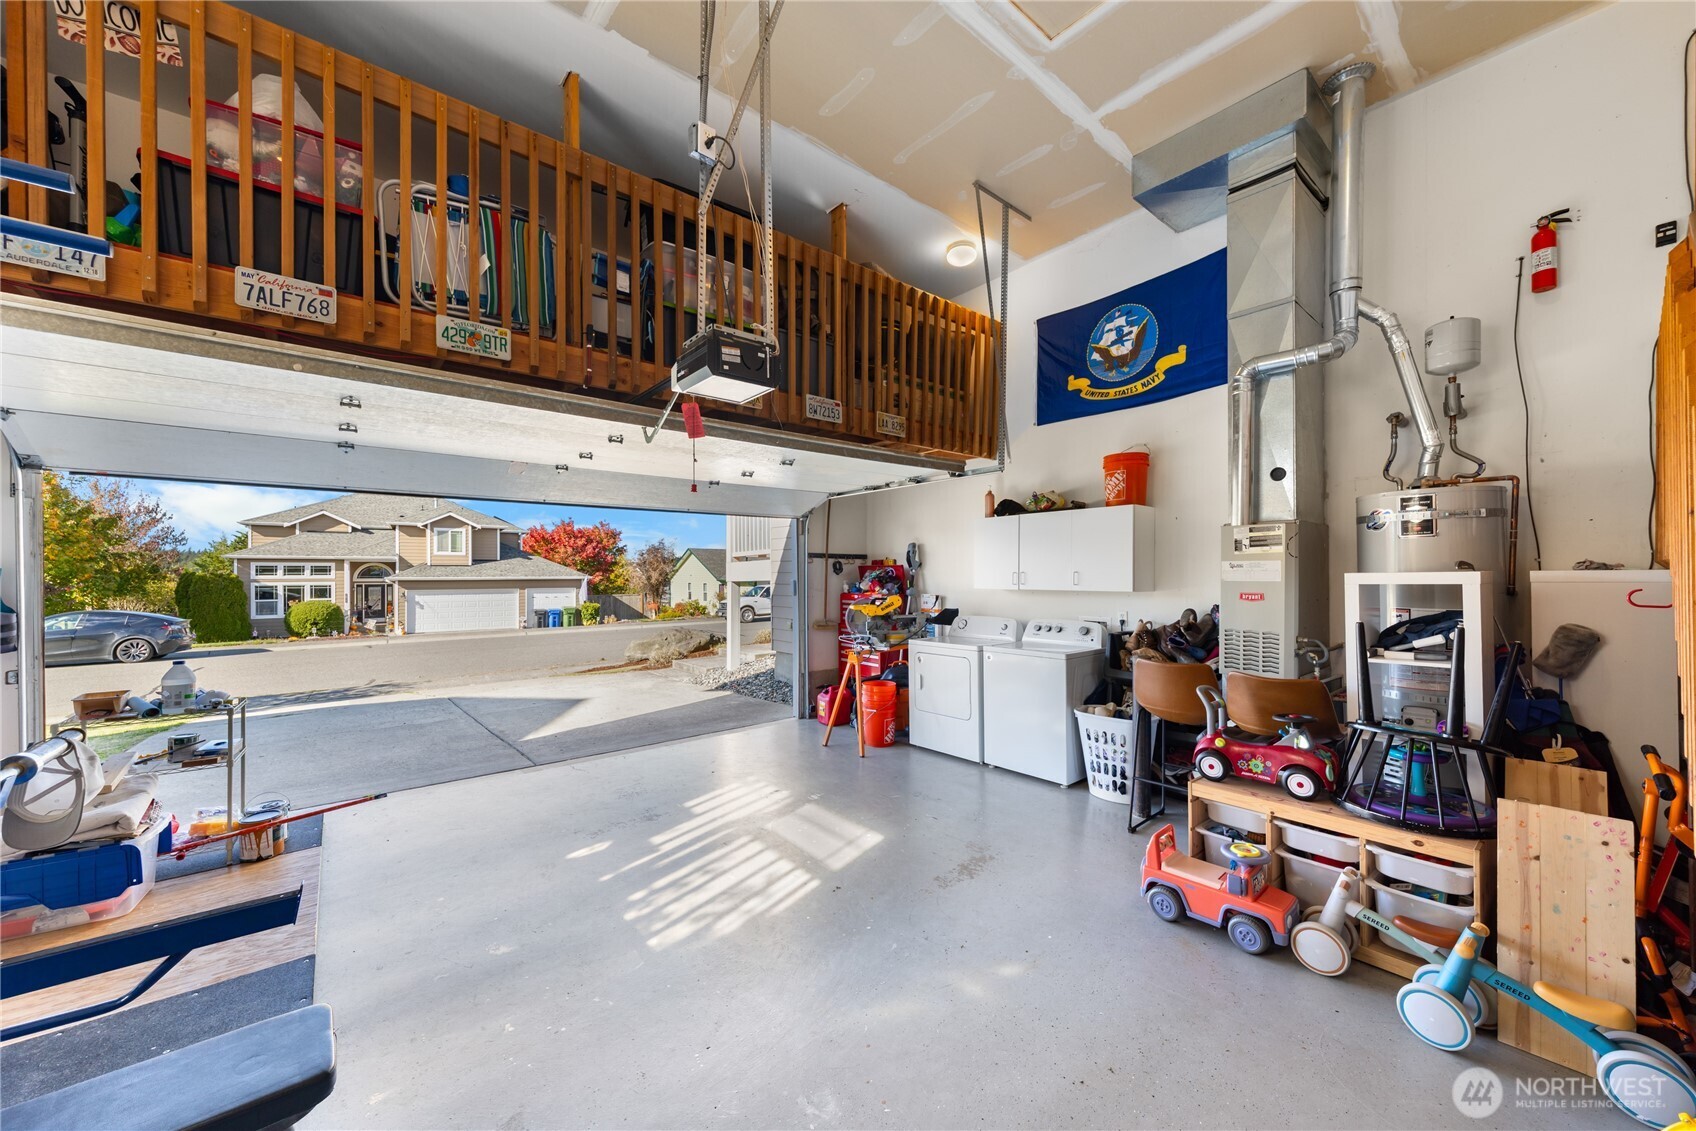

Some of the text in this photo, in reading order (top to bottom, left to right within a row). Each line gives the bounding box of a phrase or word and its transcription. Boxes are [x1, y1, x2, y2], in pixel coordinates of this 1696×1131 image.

[241, 271, 255, 280] MAY
[257, 274, 317, 295] California
[242, 282, 330, 317] 7ALF768
[441, 325, 508, 353] 429 9TR
[1084, 373, 1161, 398] UNITED STATES NAVY
[808, 403, 841, 420] 8W72153
[1362, 913, 1390, 931] SEREED
[1494, 979, 1531, 1001] SEREED
